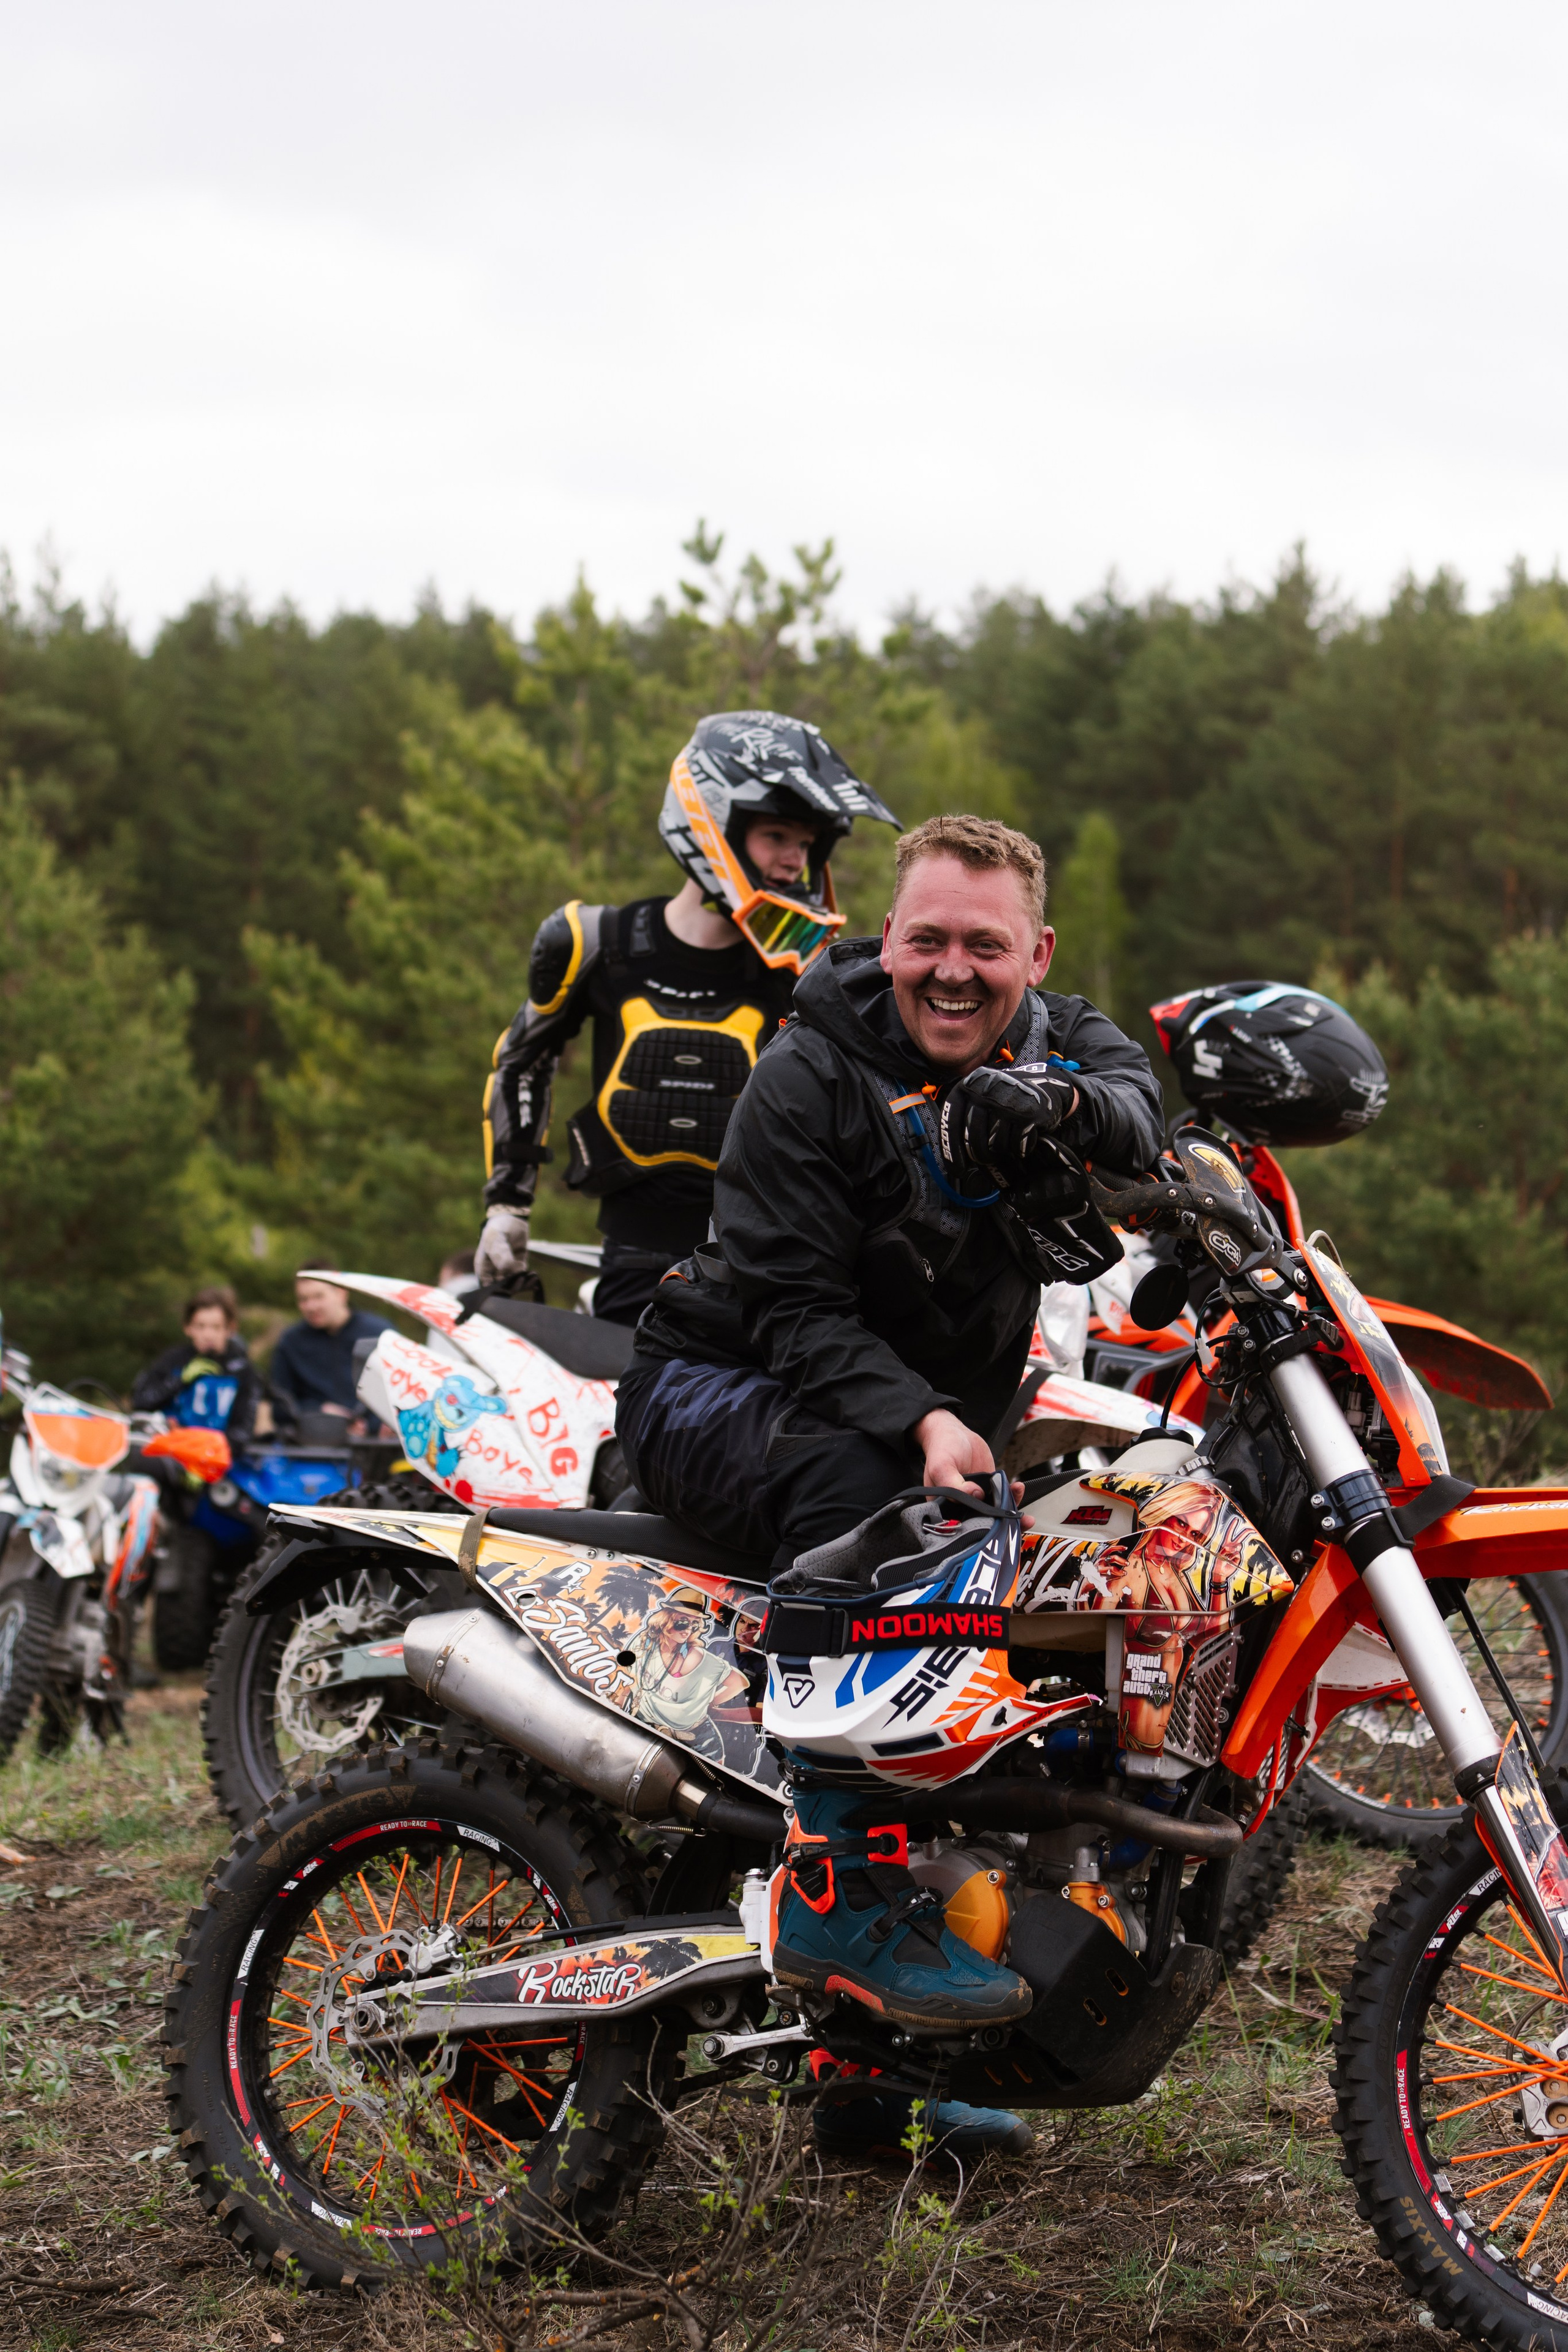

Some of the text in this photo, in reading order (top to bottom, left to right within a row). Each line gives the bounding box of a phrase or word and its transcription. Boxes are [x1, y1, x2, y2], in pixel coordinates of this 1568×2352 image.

[940, 1101, 953, 1163] SCOYCO
[528, 1396, 579, 1478] BIG
[1068, 1507, 1111, 1520] KTM
[852, 1612, 1004, 1643] SHAMOON
[522, 1597, 635, 1697] Santos
[1126, 1653, 1161, 1669] grand
[1123, 1680, 1152, 1695] auto
[1131, 1666, 1167, 1684] theft
[380, 1822, 399, 1832] READY
[463, 1828, 491, 1845] RACING
[241, 1937, 258, 1972] RACING
[229, 2046, 238, 2070] READY
[556, 2087, 574, 2124] RACING
[1400, 2104, 1411, 2130] READY
[1399, 2195, 1464, 2277] MAXXIS
[1537, 2301, 1568, 2321] ACING
